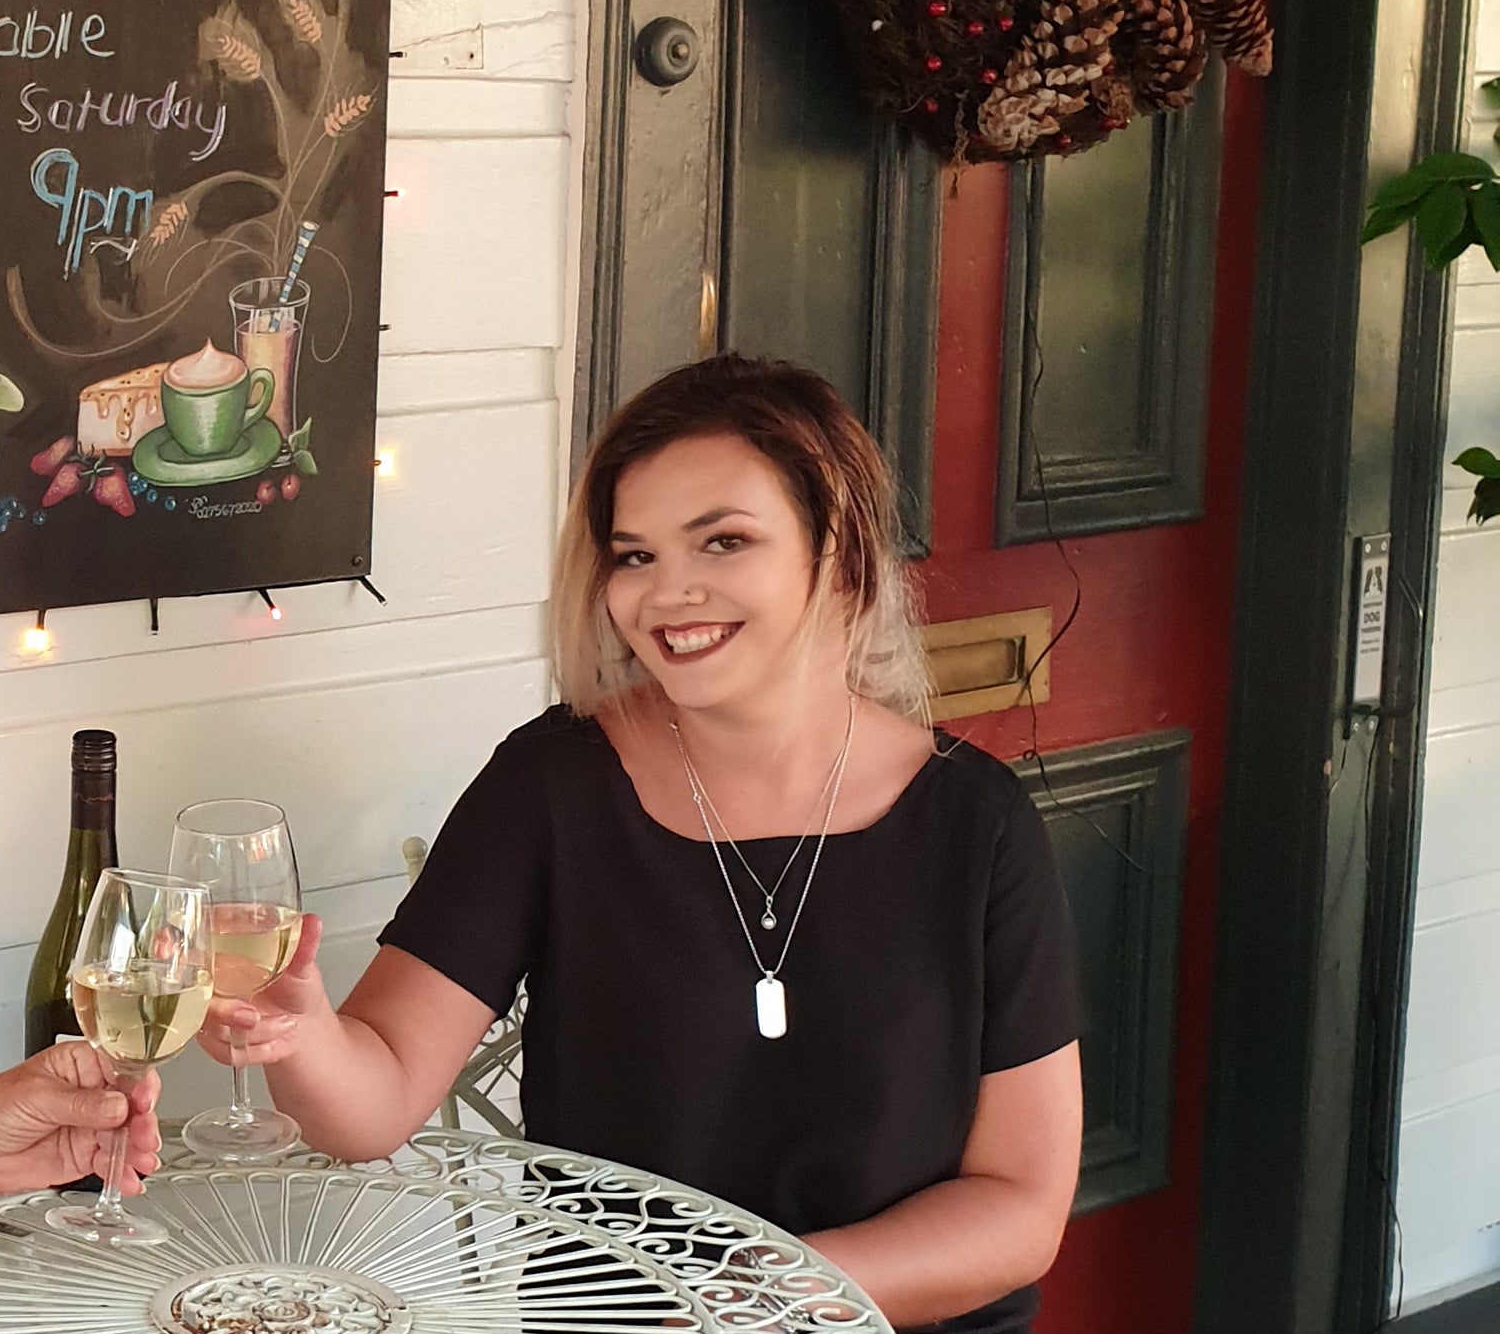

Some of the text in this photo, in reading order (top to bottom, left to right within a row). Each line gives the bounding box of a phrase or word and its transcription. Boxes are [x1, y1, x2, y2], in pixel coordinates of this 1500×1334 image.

[17, 79, 227, 162] Saturday
[30, 148, 154, 281] 9pm
[1363, 610, 1381, 624] DOG
